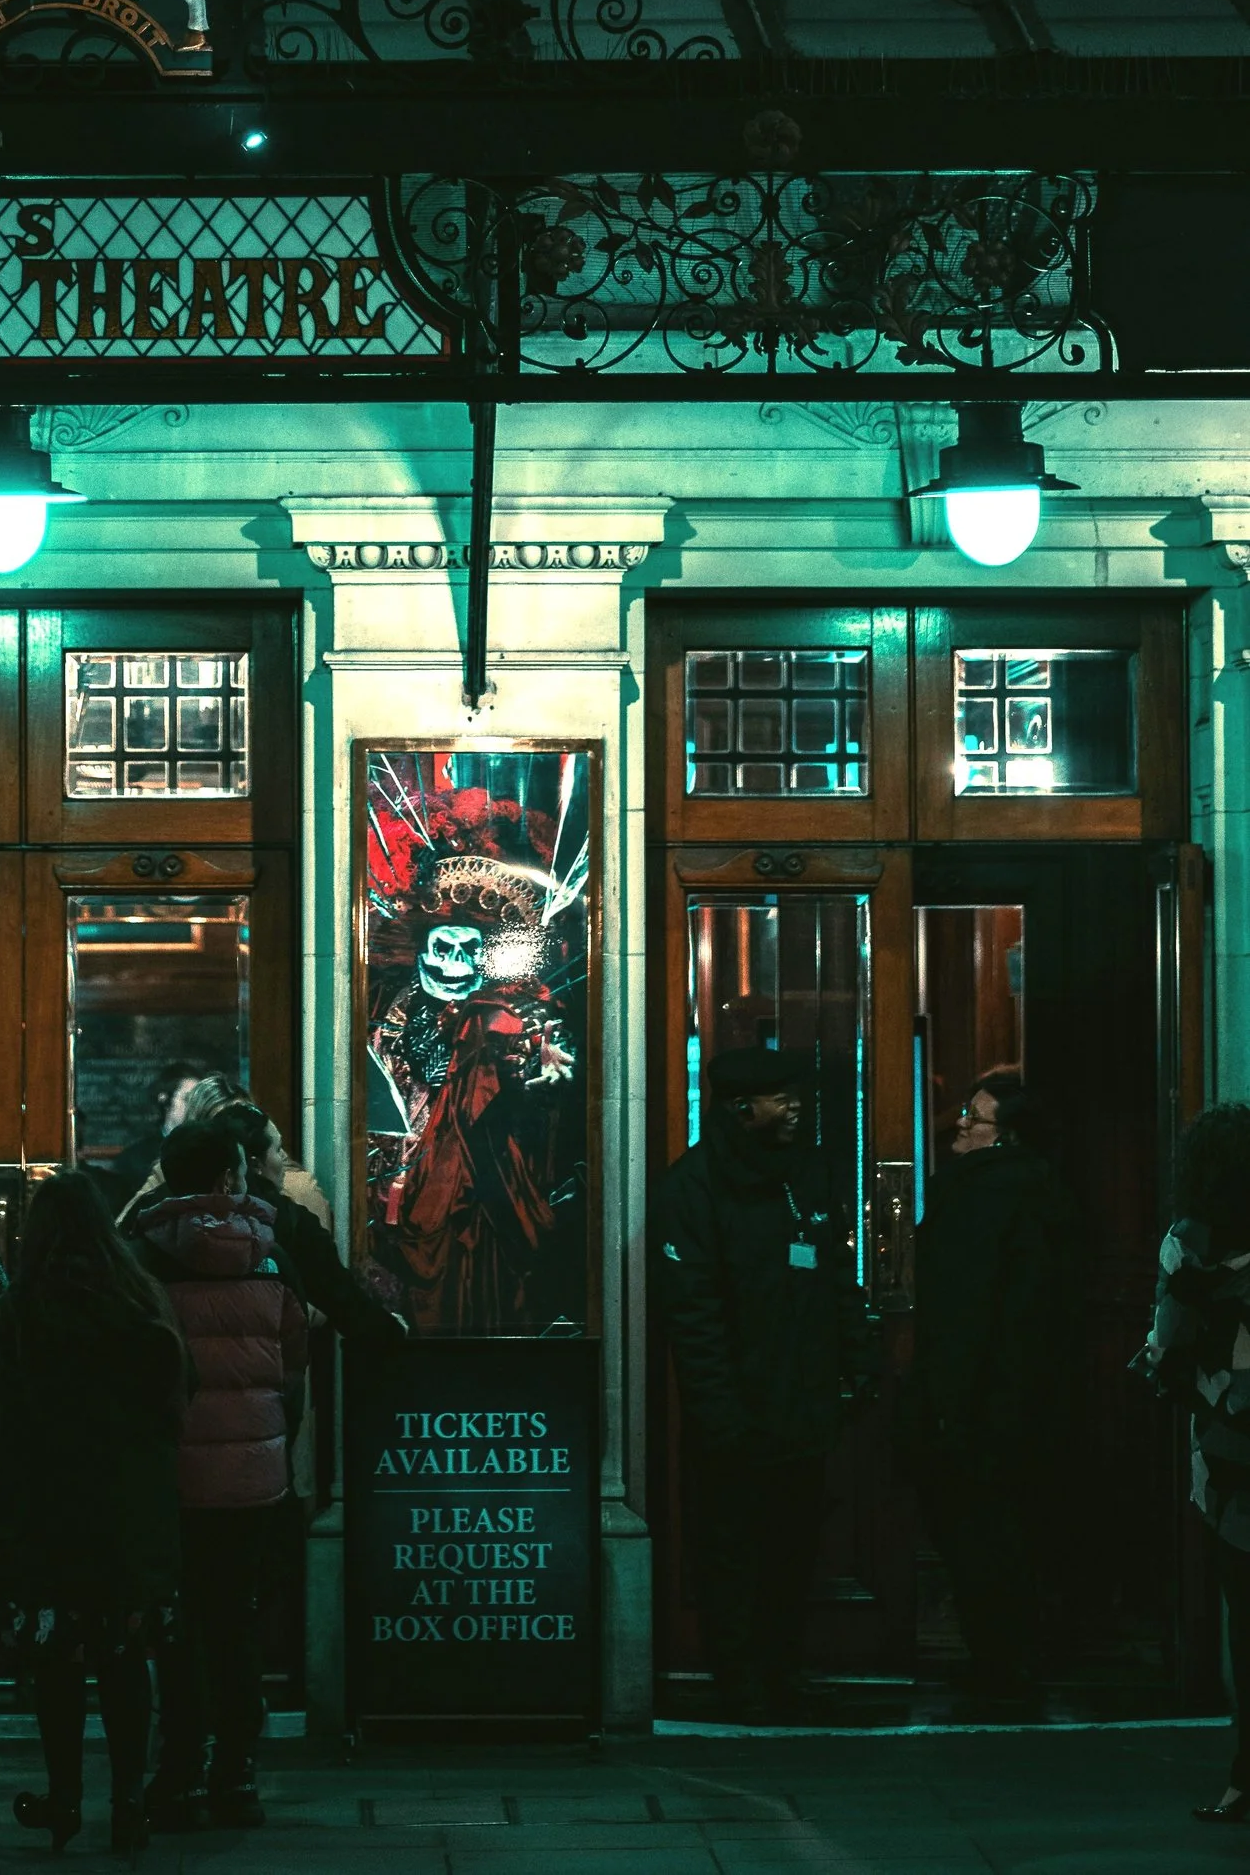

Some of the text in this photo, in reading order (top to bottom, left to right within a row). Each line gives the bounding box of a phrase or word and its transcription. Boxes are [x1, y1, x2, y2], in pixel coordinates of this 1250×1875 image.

[22, 258, 396, 341] THEATRE
[396, 1412, 547, 1439] TICKETS
[374, 1448, 570, 1475] AVAILABLE
[410, 1507, 535, 1534] PLEASE
[394, 1543, 552, 1574] REQUEST
[411, 1579, 536, 1605] AT THE
[372, 1614, 575, 1641] BOX OFFICE
